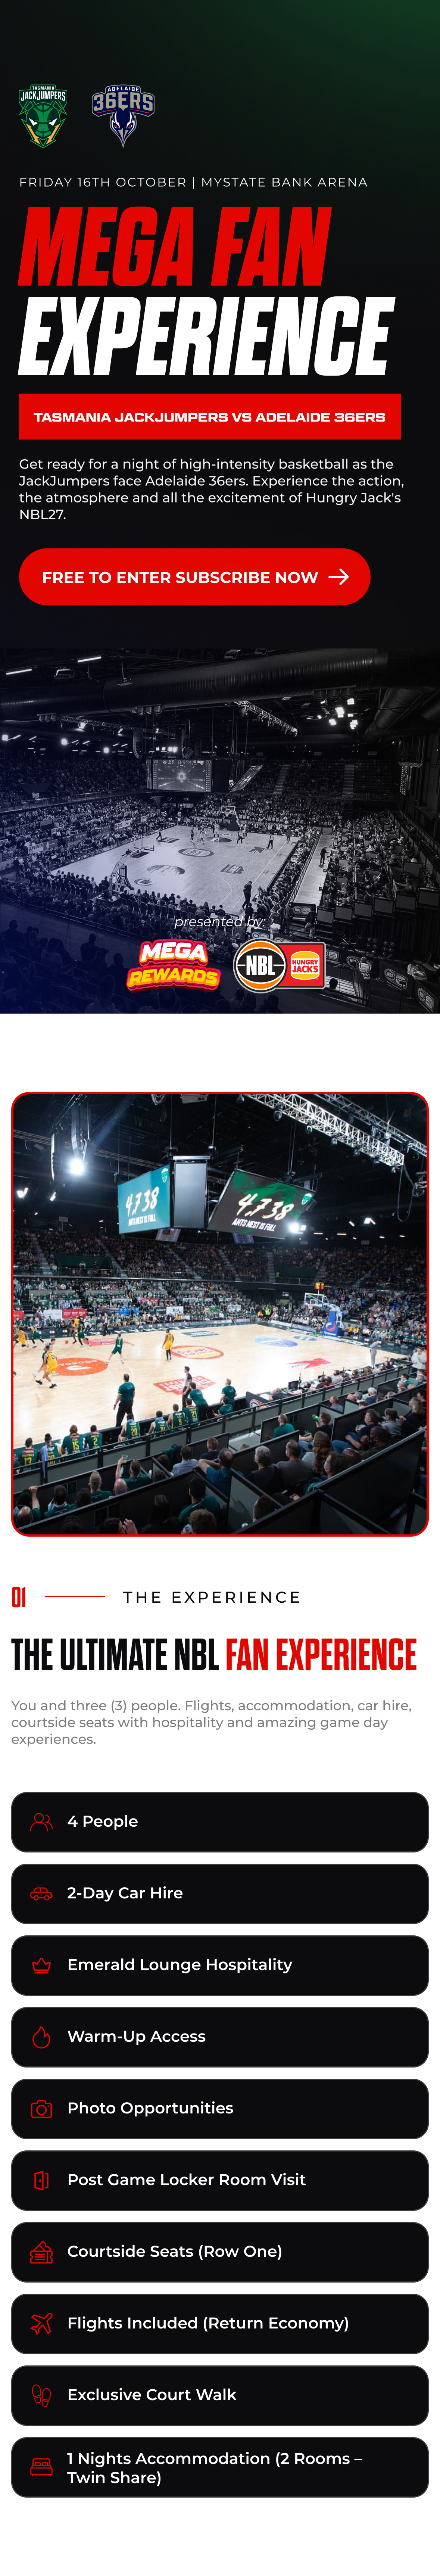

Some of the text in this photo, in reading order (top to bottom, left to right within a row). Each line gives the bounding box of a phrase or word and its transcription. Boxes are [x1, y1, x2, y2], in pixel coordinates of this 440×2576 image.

[236, 1192, 294, 1221] 4,738
[231, 1218, 248, 1227] ANTS
[246, 1220, 261, 1228] NEST
[264, 1223, 277, 1232] FULL
[72, 1441, 80, 1450] 15
